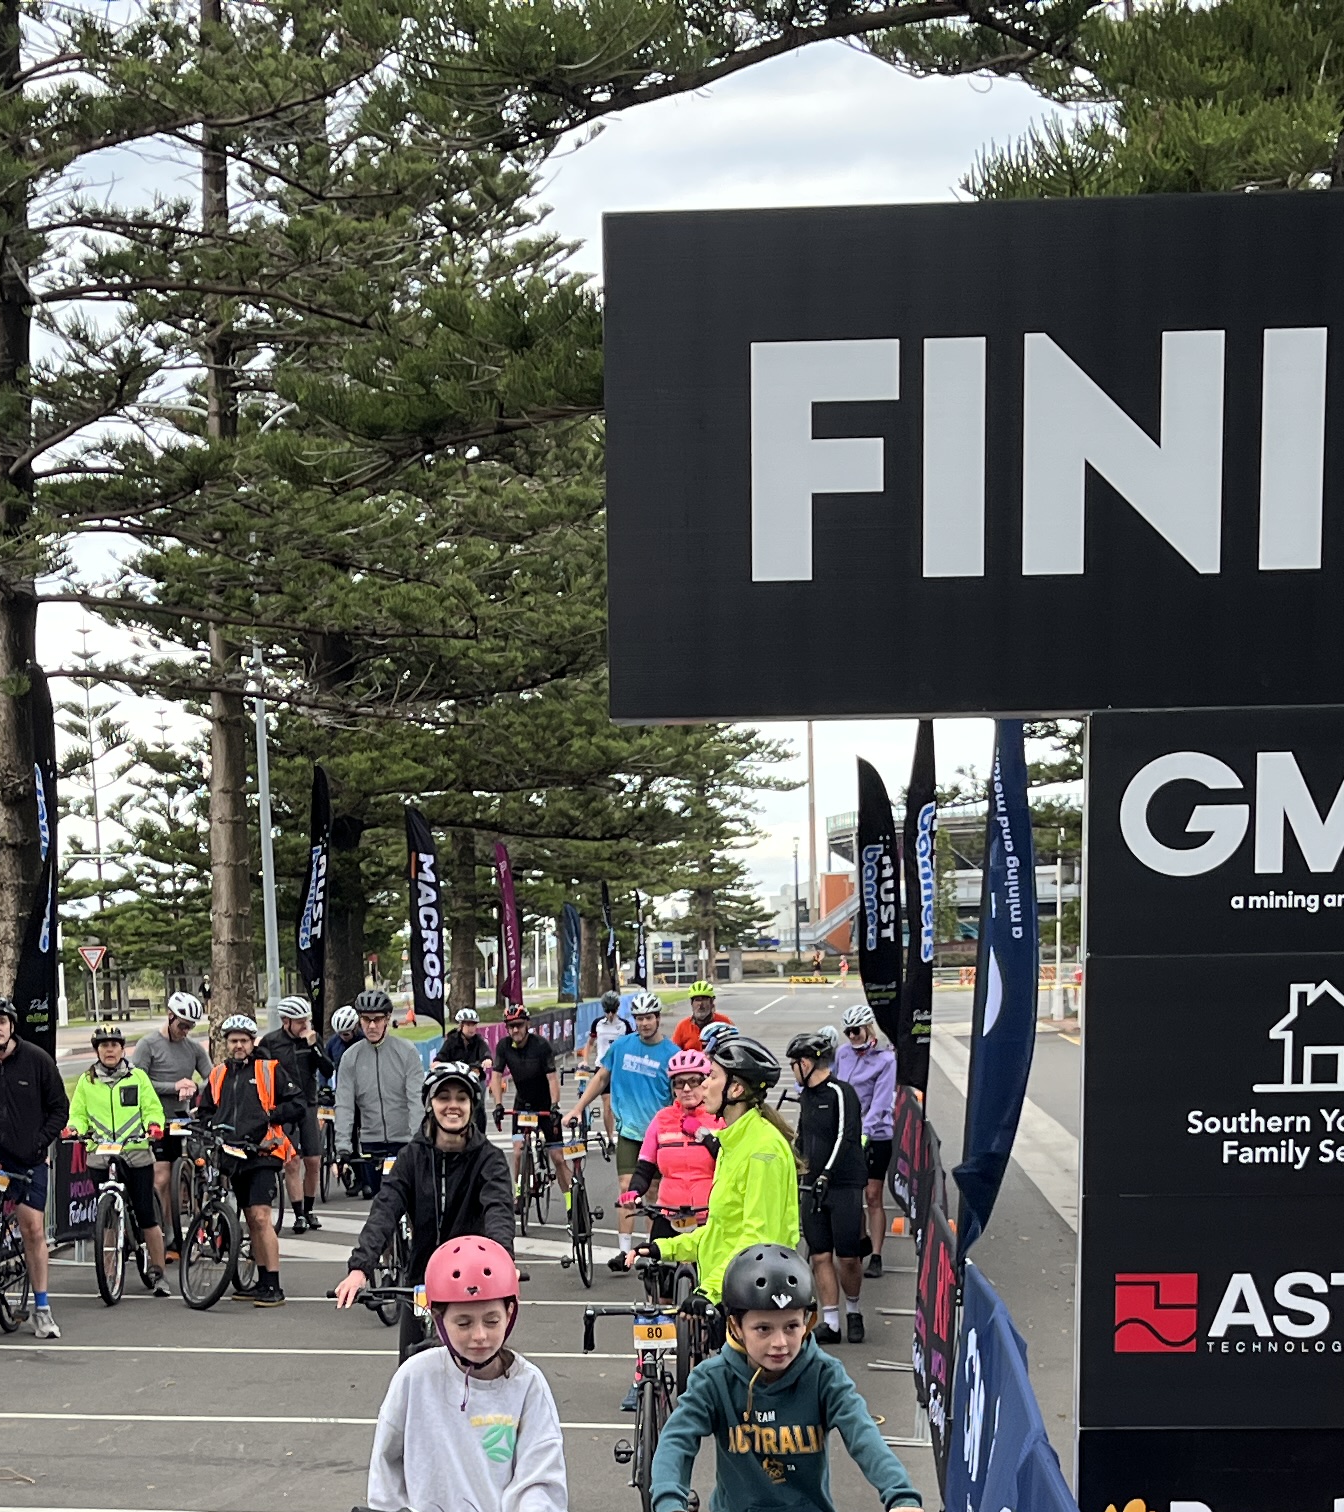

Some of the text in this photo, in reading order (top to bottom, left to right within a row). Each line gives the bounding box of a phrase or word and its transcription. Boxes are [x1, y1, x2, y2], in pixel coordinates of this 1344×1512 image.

[996, 816, 1015, 854] and
[862, 843, 884, 951] banners
[1004, 856, 1024, 923] mining
[1230, 895, 1244, 909] a
[1249, 890, 1319, 912] mining
[417, 852, 443, 1000] MACROS
[1012, 927, 1024, 941] a
[1187, 1108, 1311, 1134] Southern
[1222, 1138, 1311, 1169] Family
[647, 1327, 663, 1339] 80
